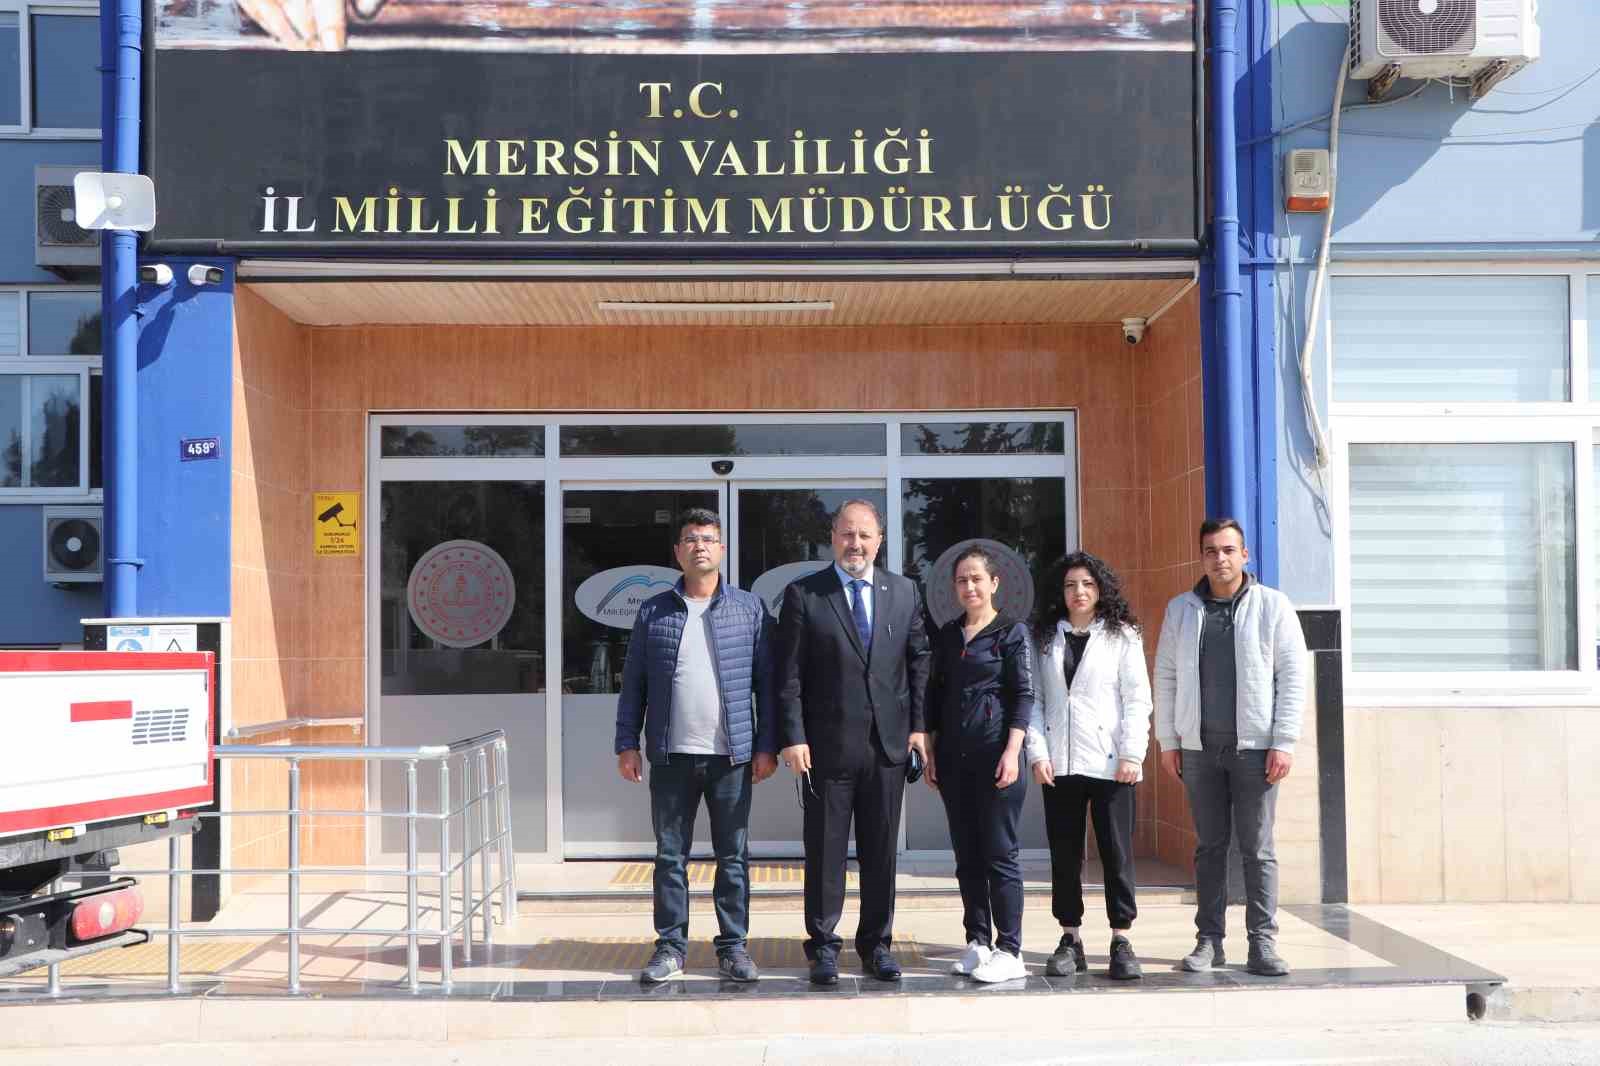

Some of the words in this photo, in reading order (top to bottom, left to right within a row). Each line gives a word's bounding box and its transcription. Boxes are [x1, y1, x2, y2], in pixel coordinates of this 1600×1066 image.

[638, 81, 739, 120] T.C.
[442, 129, 664, 177] MERSİN
[679, 127, 935, 177] VALİLİĞİ
[259, 186, 317, 233] İL
[331, 187, 501, 235] MİLLİ
[517, 186, 731, 234] EĞİTİM
[747, 183, 1113, 235] MÜDÜRLÜĞÜ
